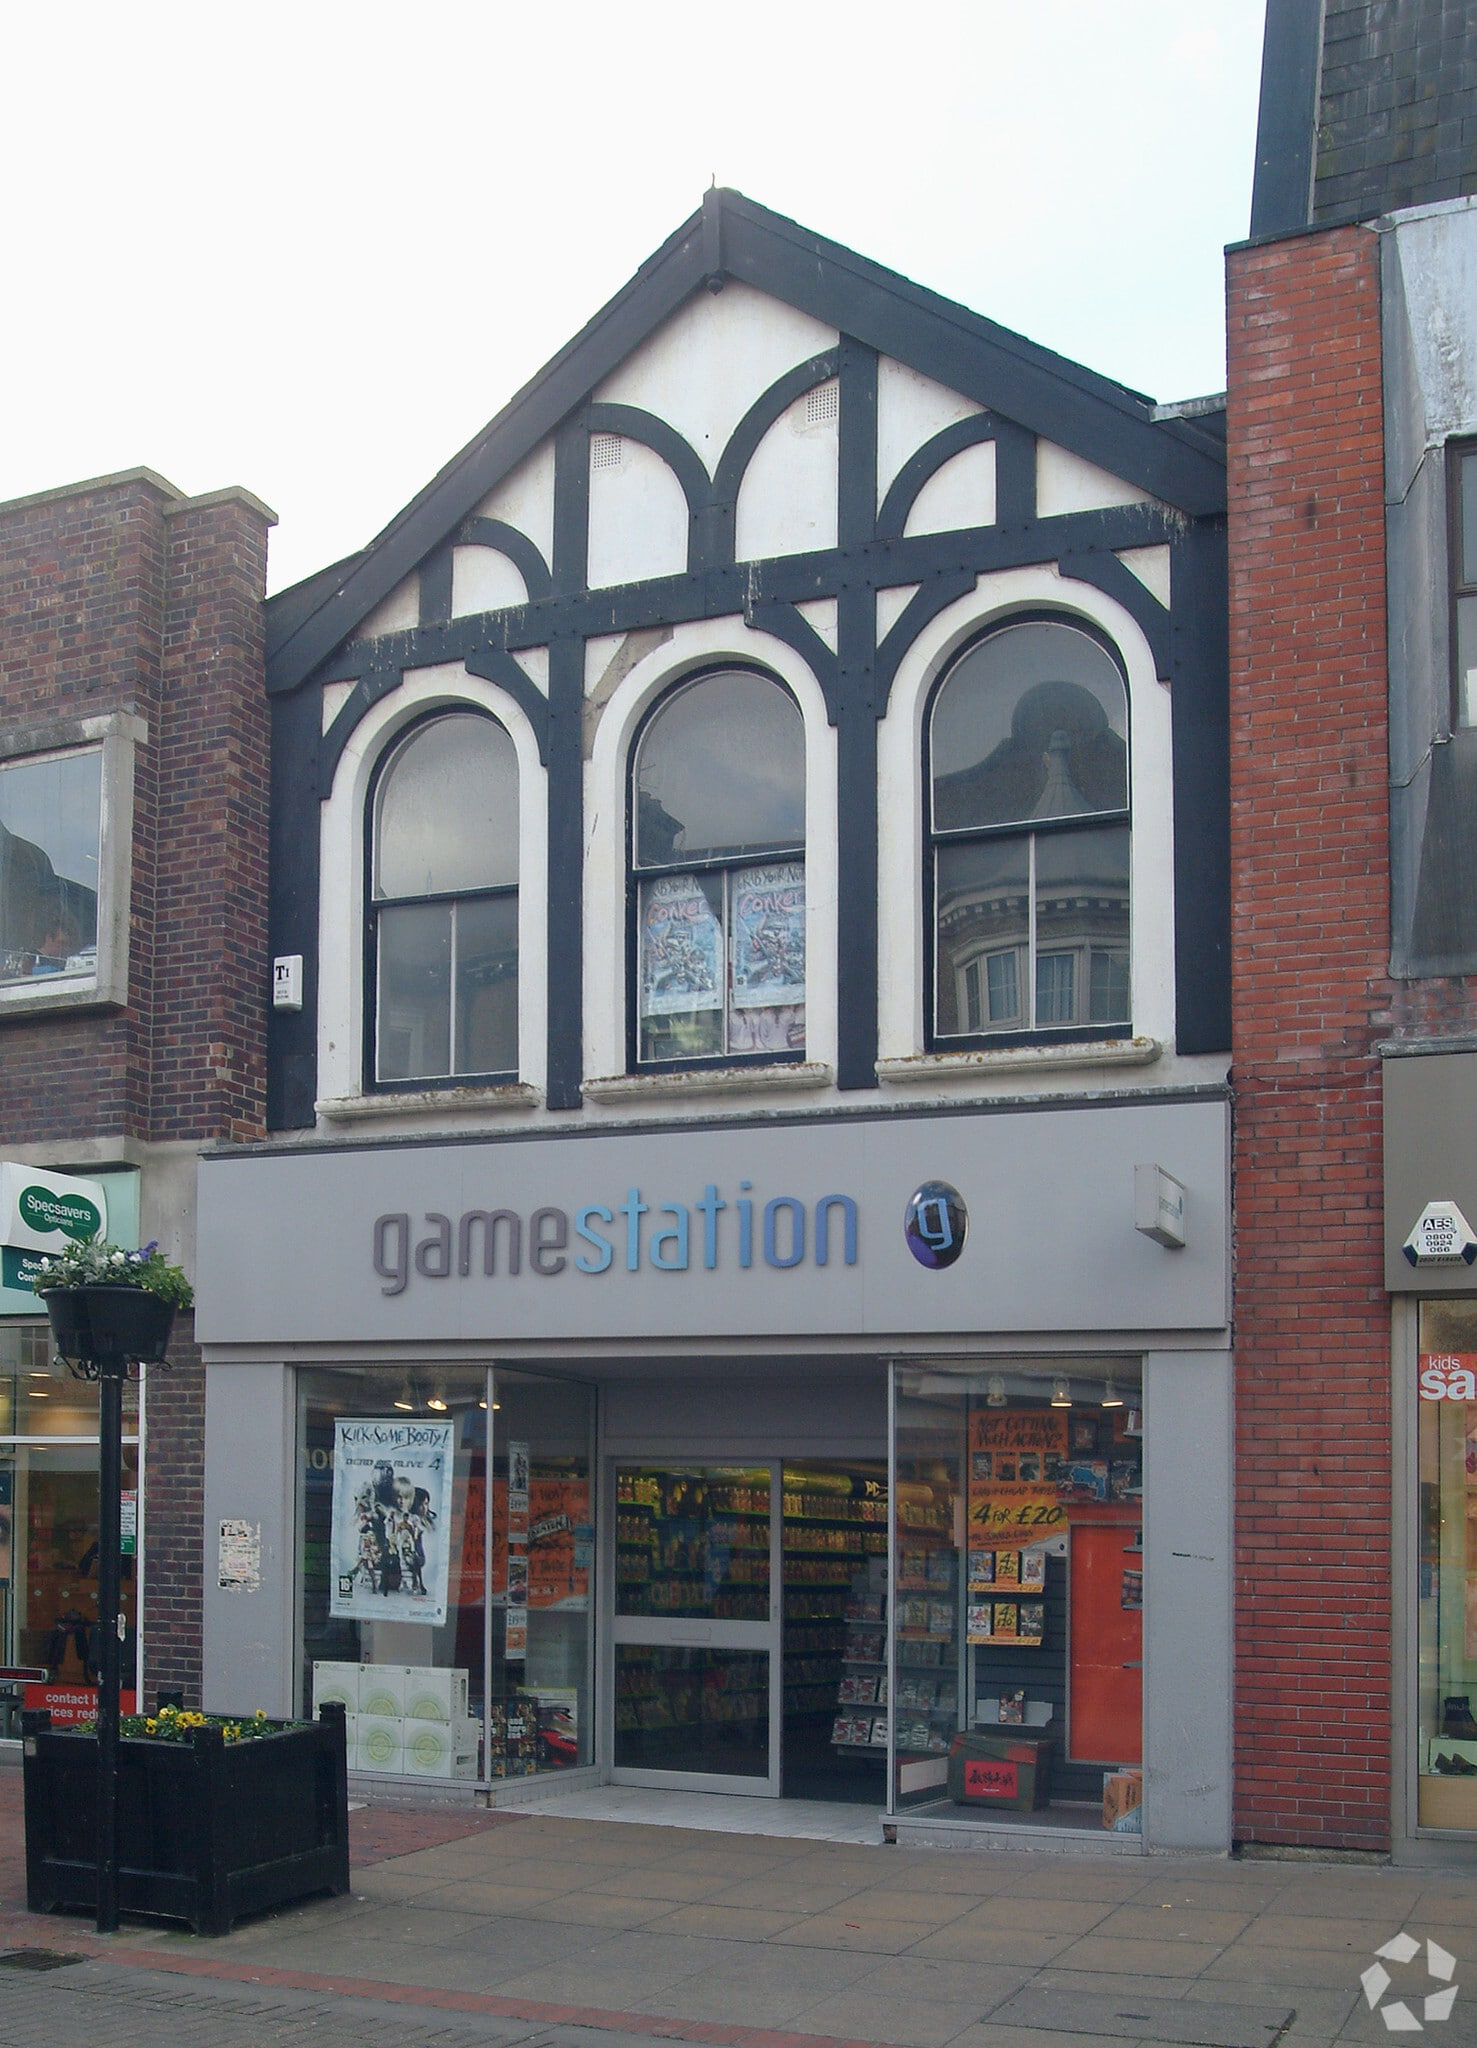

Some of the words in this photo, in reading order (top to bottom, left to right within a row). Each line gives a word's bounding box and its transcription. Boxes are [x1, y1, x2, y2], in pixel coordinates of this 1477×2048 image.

[27, 1195, 91, 1221] Specsavers
[1423, 1218, 1453, 1231] AES
[373, 1180, 858, 1296] gamestation
[1425, 1233, 1453, 1241] 0800
[1429, 1355, 1461, 1370] kids
[428, 1458, 441, 1470] 4
[973, 1503, 991, 1523] 4
[1016, 1505, 1063, 1524] £20
[45, 1692, 89, 1705] contact
